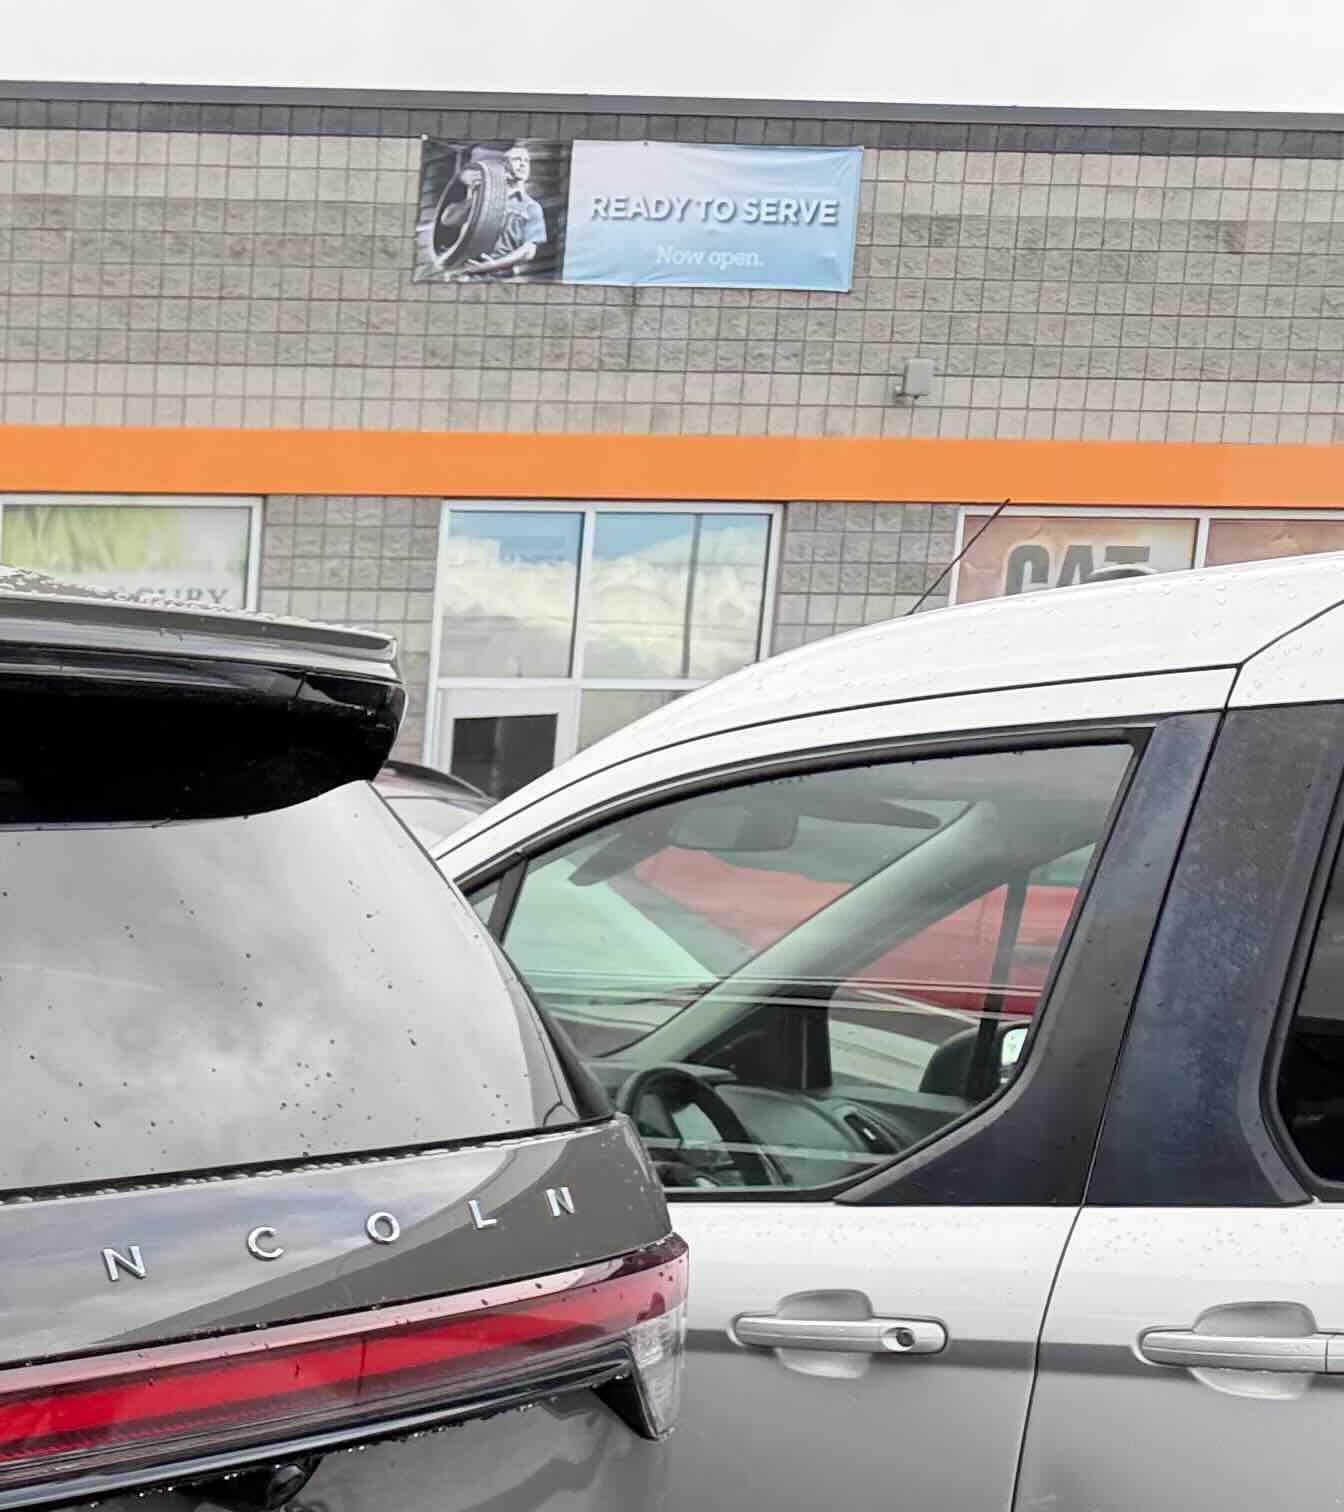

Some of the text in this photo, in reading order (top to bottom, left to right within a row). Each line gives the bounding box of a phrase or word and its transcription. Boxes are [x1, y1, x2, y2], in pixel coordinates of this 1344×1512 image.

[591, 194, 840, 226] READY TO SERVE
[655, 244, 764, 271] Now open.
[1004, 544, 1151, 597] CA
